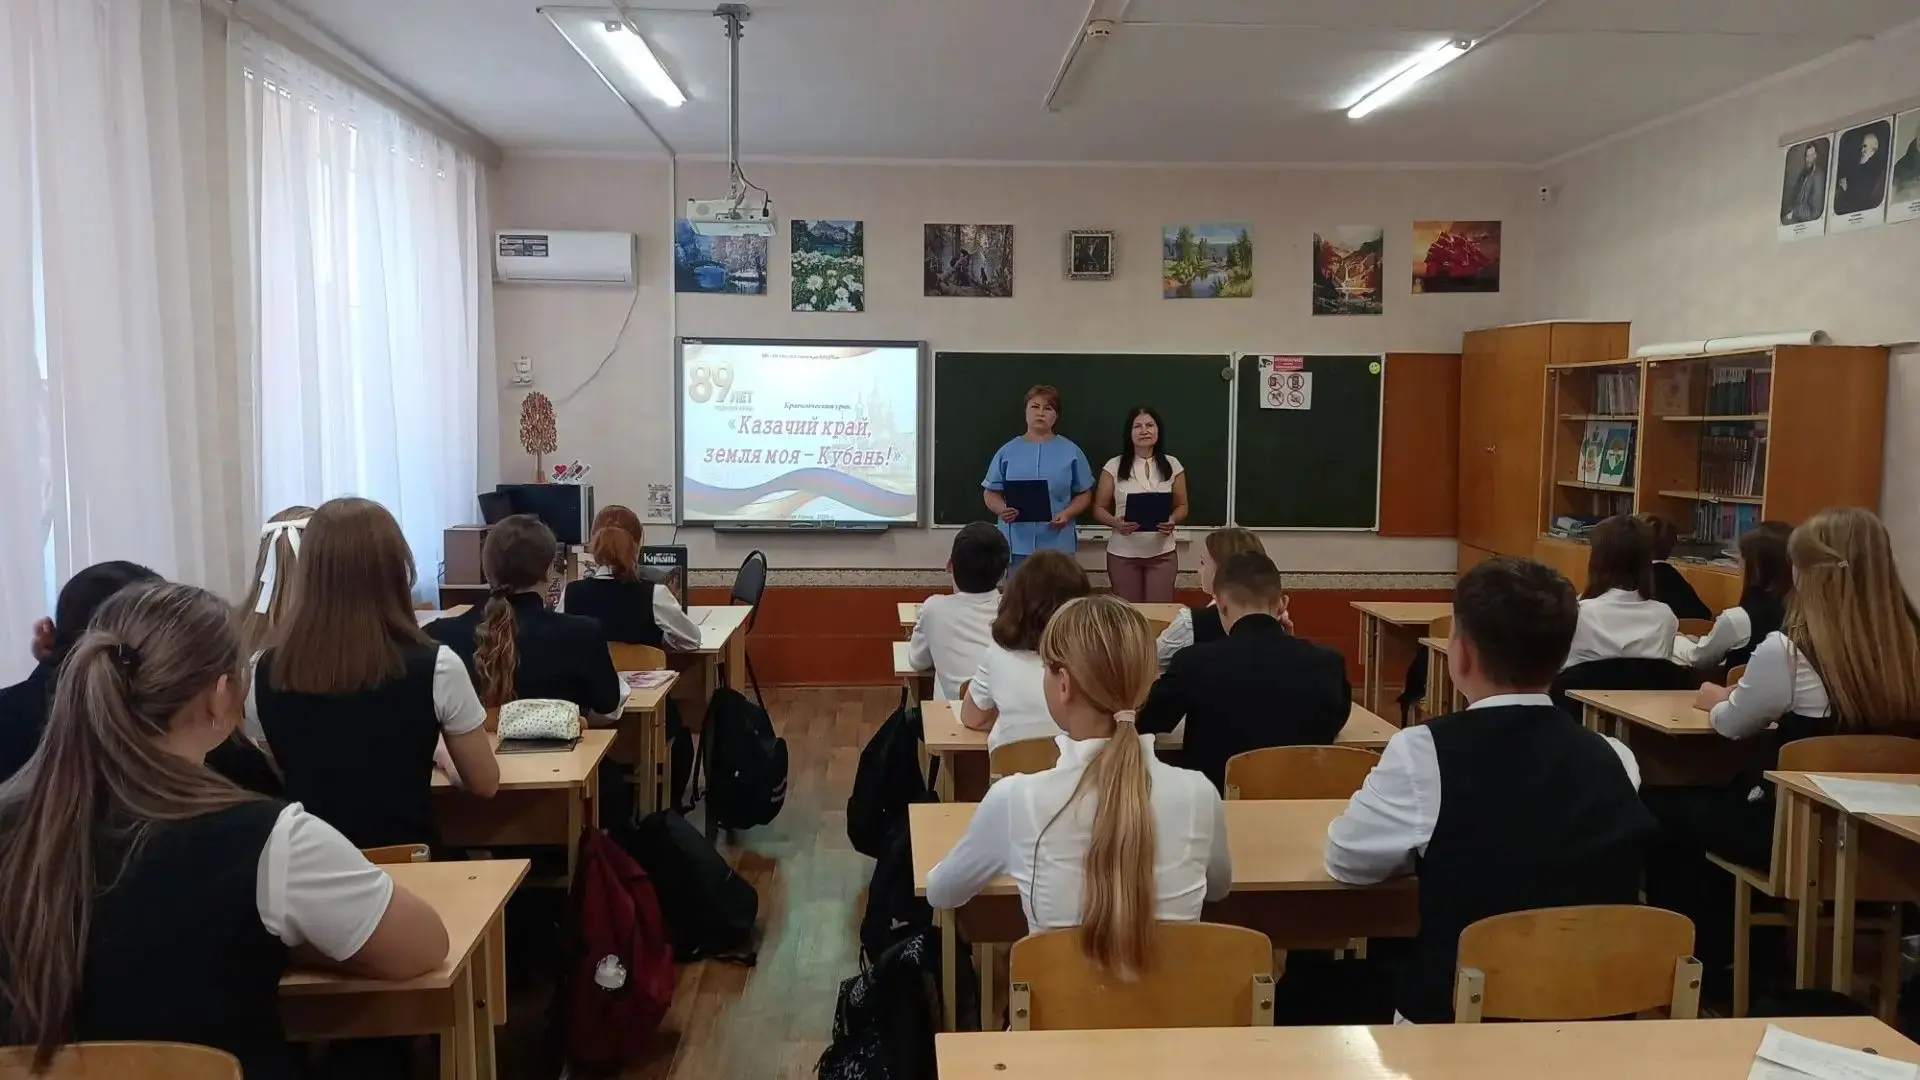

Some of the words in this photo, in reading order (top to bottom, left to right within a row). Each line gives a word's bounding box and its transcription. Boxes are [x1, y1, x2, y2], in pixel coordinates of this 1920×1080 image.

[688, 361, 734, 403] 89
[821, 416, 871, 438] край,
[703, 447, 760, 465] земля
[765, 449, 800, 465] моя
